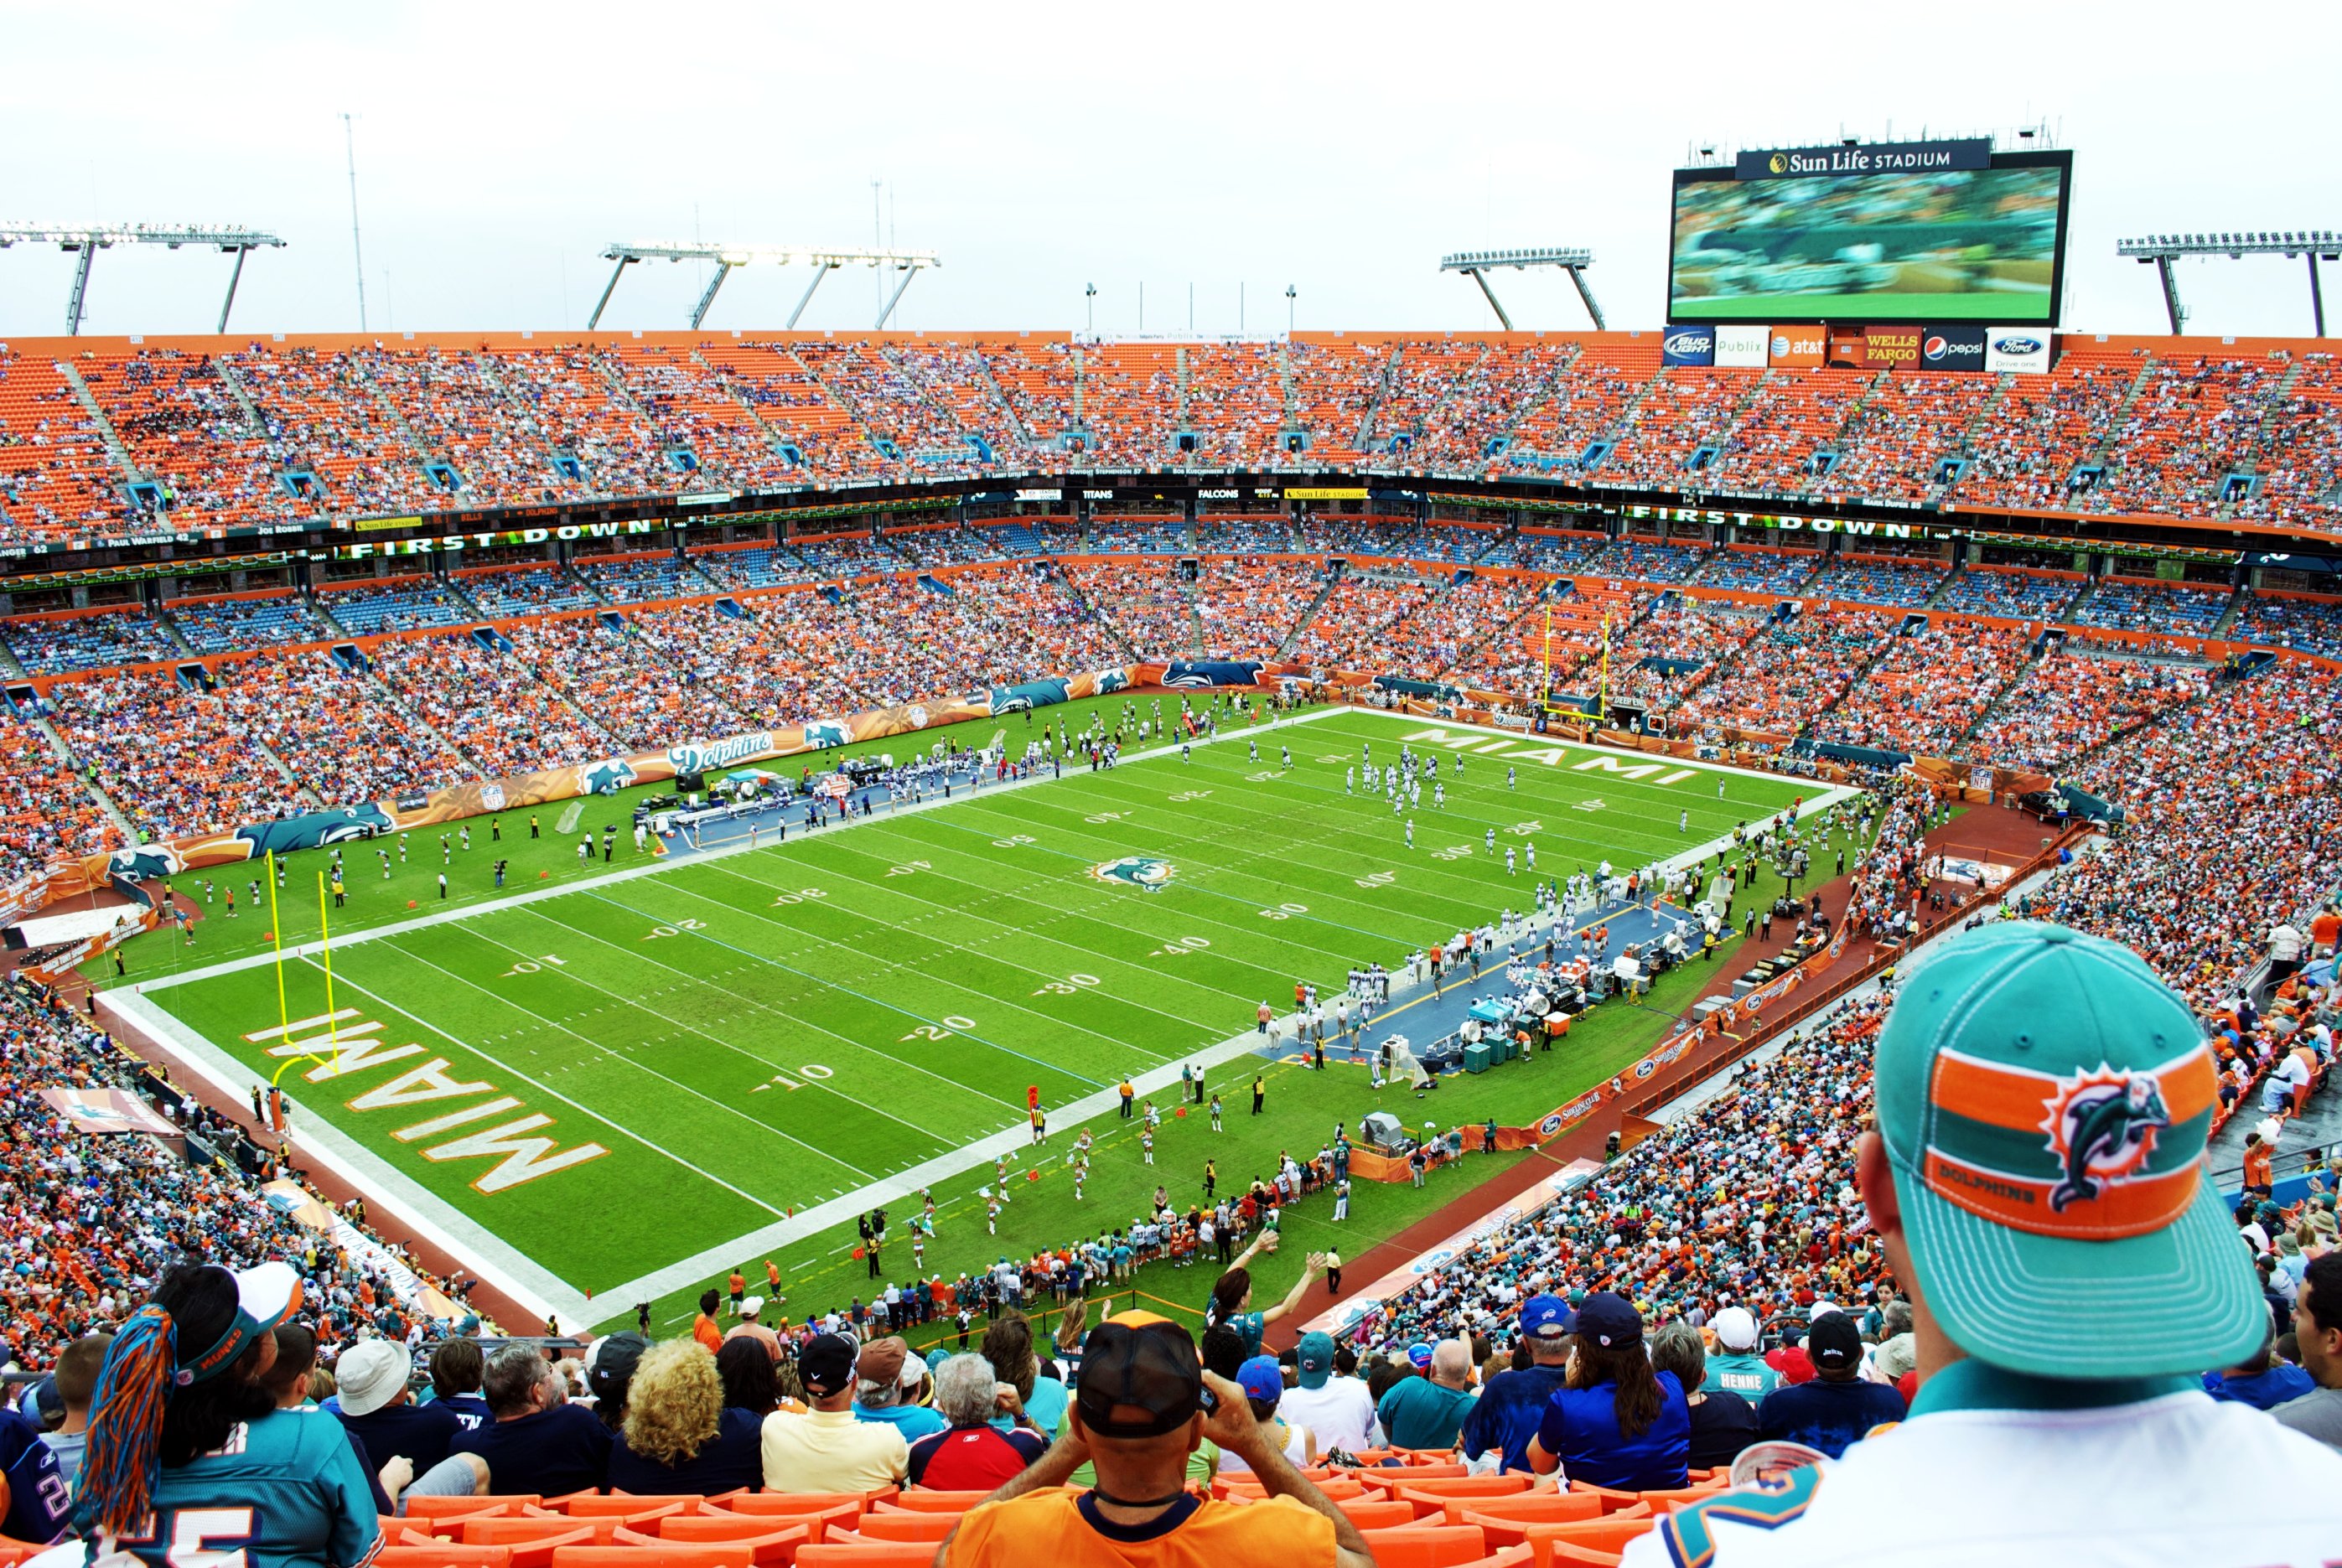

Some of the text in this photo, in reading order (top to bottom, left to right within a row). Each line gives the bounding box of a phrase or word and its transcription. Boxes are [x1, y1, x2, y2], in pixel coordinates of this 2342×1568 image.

[1790, 150, 1951, 173] Sun Life STADIUM
[1676, 335, 1711, 346] BUD
[1718, 340, 1762, 352] Publix
[1792, 339, 1825, 354] at&t
[1867, 334, 1918, 347] WELLS
[2000, 337, 2035, 354] Ford
[1669, 343, 1712, 354] LIGHT
[1867, 348, 1917, 360] FARGO
[1947, 342, 1983, 355] pepsi
[773, 486, 791, 494] SHULA
[1082, 489, 1113, 499] TITANS
[1198, 489, 1239, 499] FALCONS
[1314, 489, 1331, 498] Life
[1611, 482, 1638, 491] CLAYTON
[1722, 489, 1735, 498] DAN
[1737, 491, 1763, 499] MARINO
[526, 507, 558, 517] DOLPHINS
[1884, 500, 1909, 509] DUPER
[379, 520, 394, 529] Life
[461, 513, 483, 521] BILLS
[1633, 505, 1910, 539] FIRST DOWN
[257, 525, 304, 536] JOE ROBBIE
[107, 533, 189, 548] PAUL WARFIELD 42
[350, 519, 651, 560] FIRST DOWN
[33, 545, 48, 554] 62
[1614, 696, 1631, 705] DEEP
[667, 732, 773, 774] Dolphins
[1315, 753, 1346, 764] 10
[1398, 727, 1700, 785] MIAMI
[1244, 772, 1281, 783] 20
[1973, 780, 1989, 790] NFL
[1166, 789, 1205, 802] 30
[1571, 799, 1606, 814] 10
[1083, 811, 1122, 824] 40
[1503, 821, 1542, 836] 20
[991, 835, 1038, 848] 50
[1429, 846, 1473, 862] 30
[890, 860, 932, 876] 40
[1355, 872, 1393, 891] 40
[776, 887, 828, 905] 30
[1258, 903, 1309, 921] 50
[651, 918, 707, 938] 20
[1161, 936, 1211, 958] 40
[511, 953, 569, 974] 10
[1043, 973, 1101, 996] 30
[914, 1016, 977, 1042] 20
[769, 1063, 834, 1092] 10
[240, 1007, 613, 1197] MIAMI
[1562, 1102, 1586, 1120] SIDELINE
[1584, 1091, 1600, 1105] CLUB
[1936, 1162, 2037, 1207] DOLPHINS
[327, 1222, 384, 1262] LOCKER
[1418, 1255, 1448, 1271] Ford
[1720, 1372, 1763, 1390] HENNE
